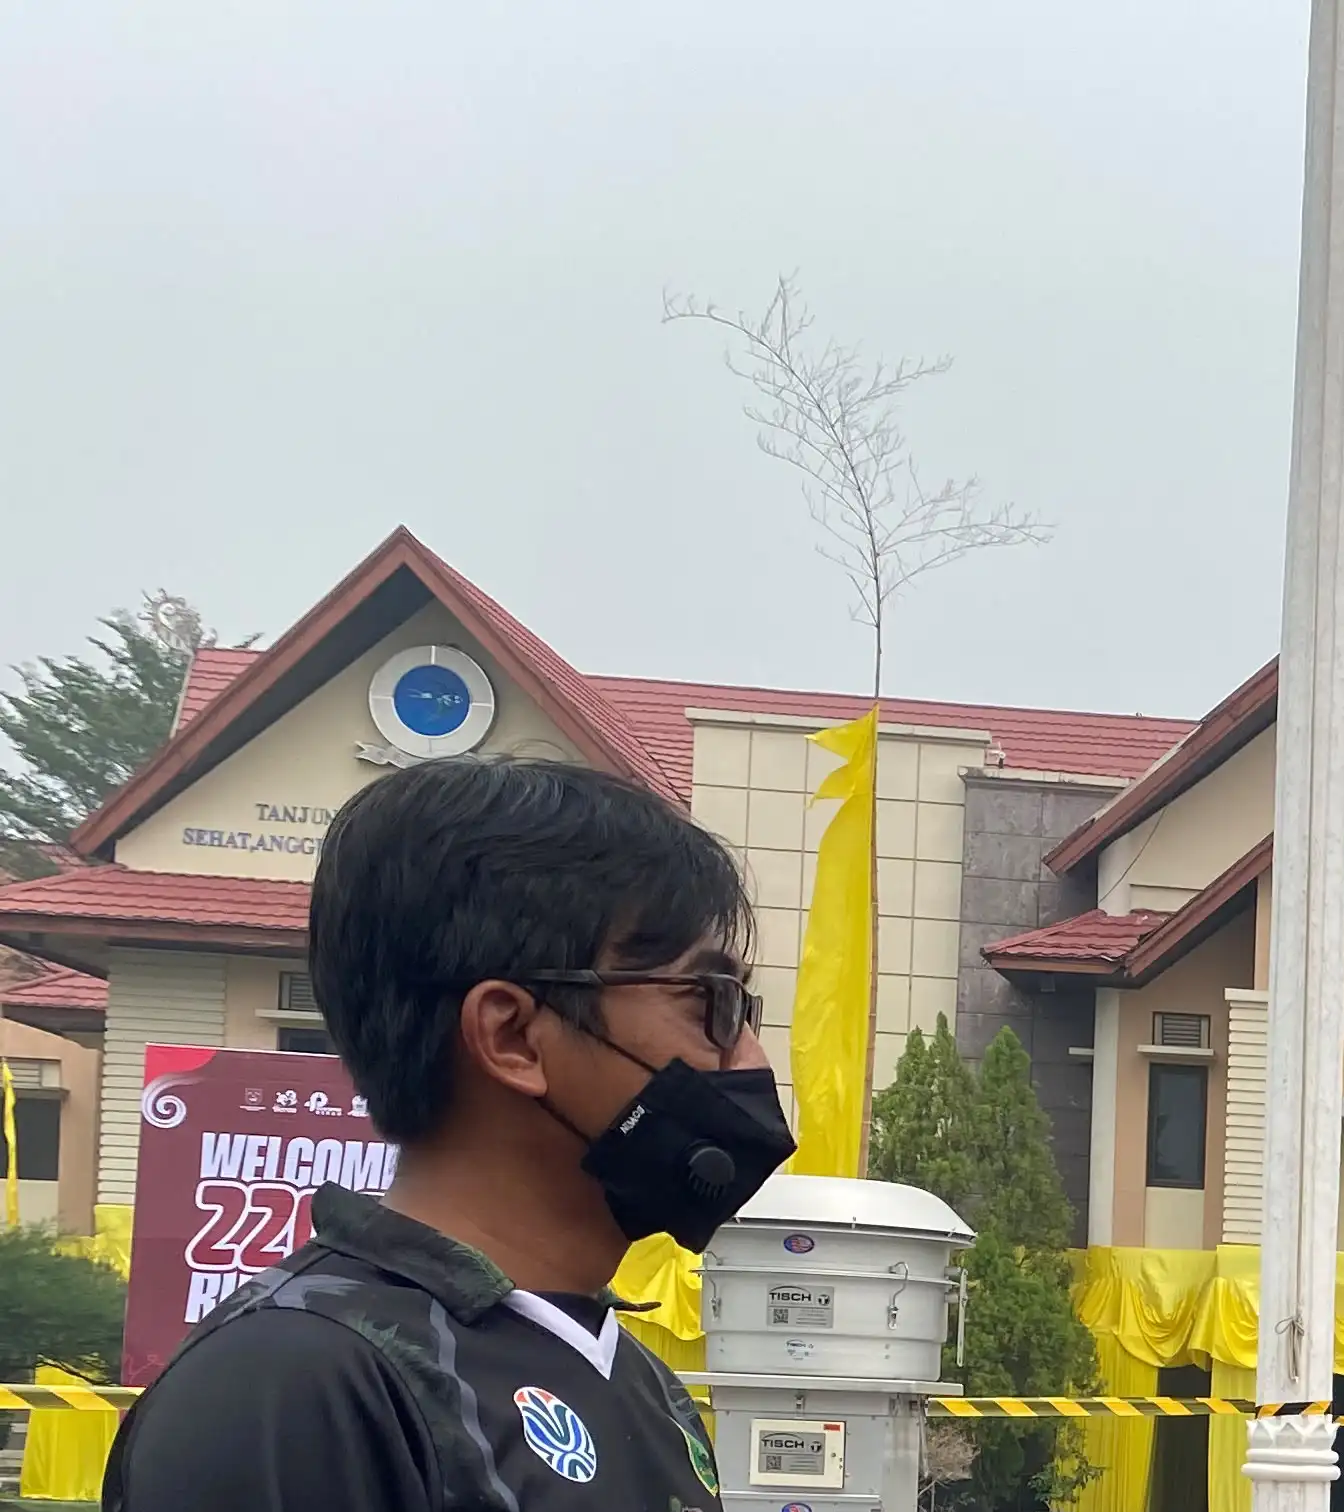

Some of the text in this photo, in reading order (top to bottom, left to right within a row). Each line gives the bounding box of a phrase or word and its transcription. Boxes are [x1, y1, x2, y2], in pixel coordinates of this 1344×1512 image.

[255, 803, 338, 826] TANJUN
[769, 1292, 812, 1302] TISCH
[761, 1438, 805, 1449] TISCH
